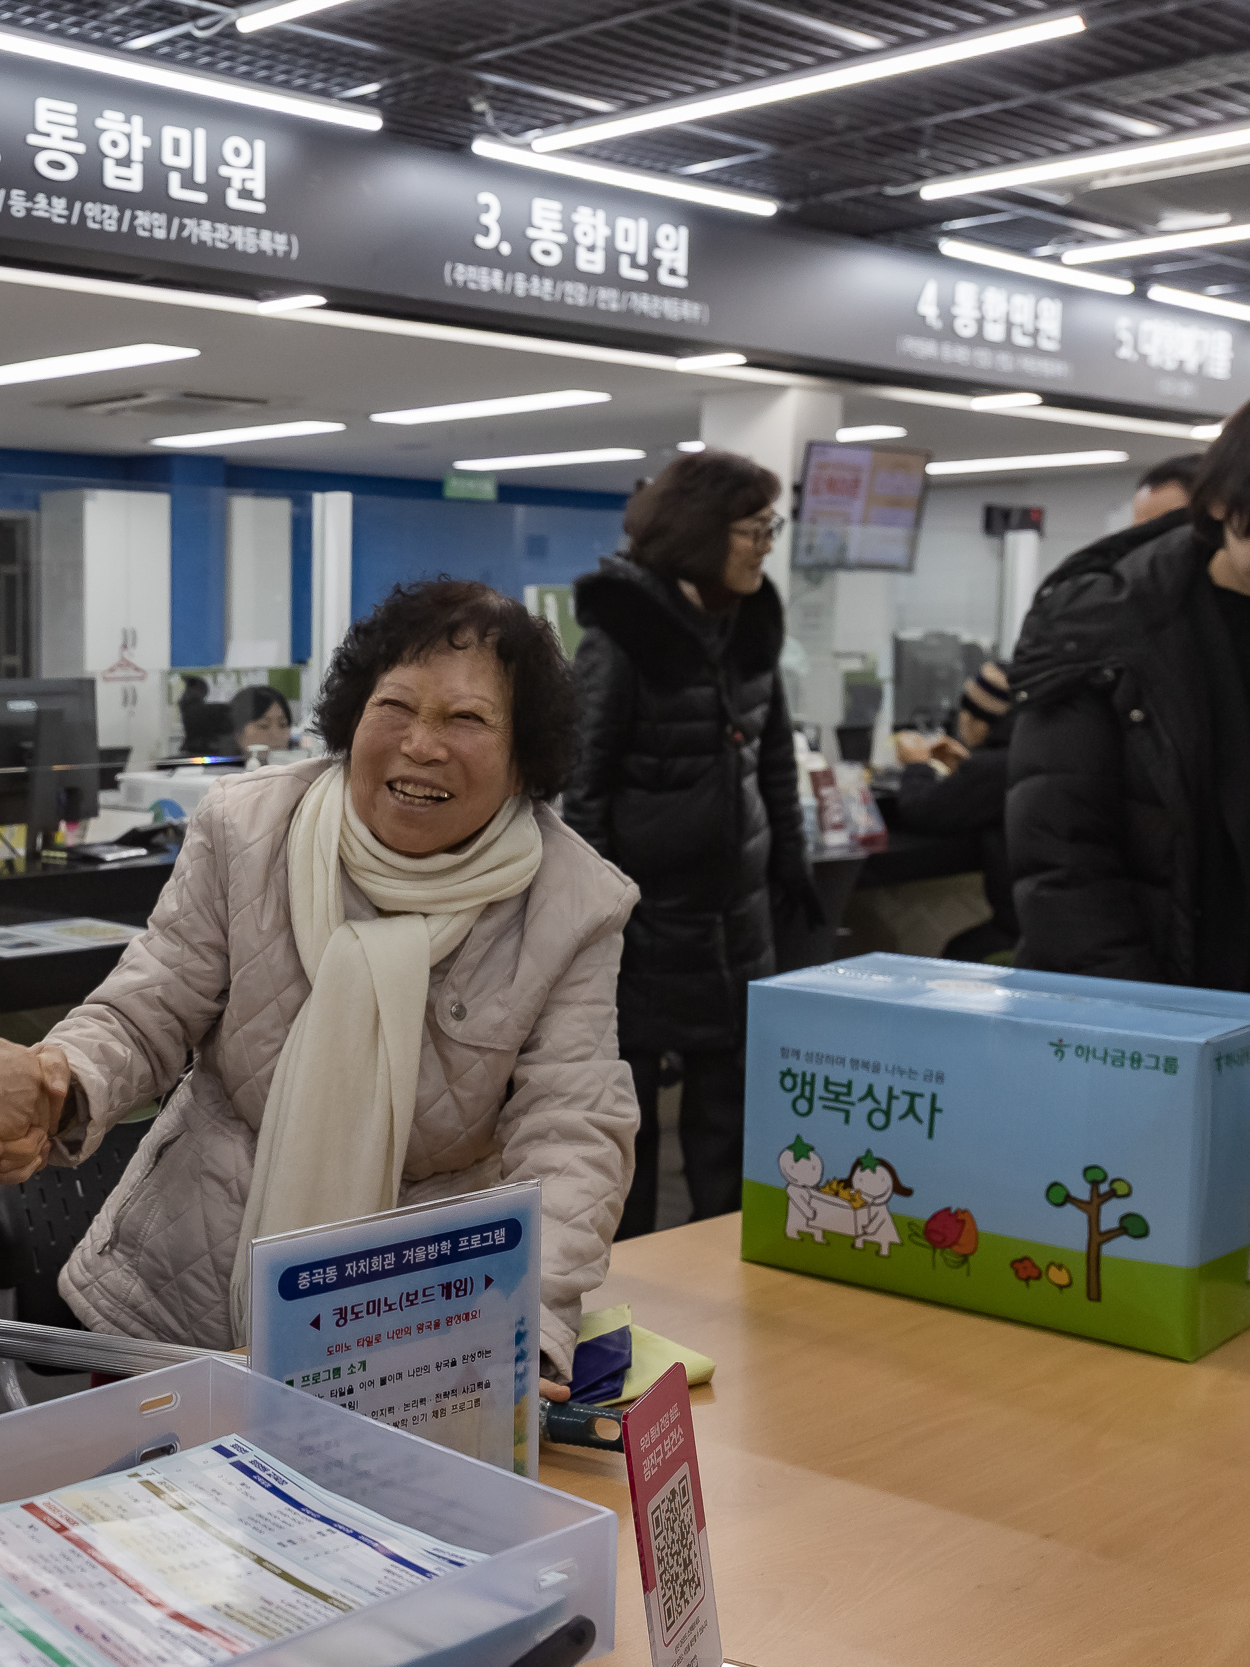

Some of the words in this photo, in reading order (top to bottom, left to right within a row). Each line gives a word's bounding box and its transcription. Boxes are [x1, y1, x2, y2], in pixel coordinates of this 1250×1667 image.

[25, 97, 267, 214] 통합민원
[84, 201, 121, 233] 인감
[474, 191, 512, 257] 3.
[525, 197, 690, 289] 통합민원
[951, 280, 1063, 352] 통합민원
[1074, 1043, 1179, 1076] 하나금융그룹
[778, 1065, 944, 1140] 행복상자
[297, 1264, 338, 1290] 중곡동
[344, 1252, 396, 1279] 자치회관
[402, 1240, 452, 1265] 겨울방학
[457, 1227, 506, 1252] 프로그램
[332, 1276, 474, 1328] 킹도미노(보드게임)
[326, 1342, 352, 1356] 도미노
[356, 1333, 382, 1348] 타일로
[386, 1326, 412, 1340] 나만의
[416, 1318, 441, 1334] 왕국을
[301, 1366, 342, 1388] 프로그램
[347, 1360, 367, 1375] 소개
[330, 1384, 354, 1398] 타일을
[359, 1379, 375, 1391] 이어
[407, 1364, 431, 1378] 나만의
[435, 1357, 457, 1372] 왕국을
[462, 1349, 492, 1364] 완성하는
[371, 1406, 395, 1420] 인지력
[403, 1397, 427, 1412] 논리력
[435, 1388, 458, 1403] 전략적
[412, 1413, 428, 1426] 인기
[451, 1398, 481, 1415] 프로그램
[642, 1443, 664, 1482] 광진구
[663, 1424, 685, 1460] 보건소
